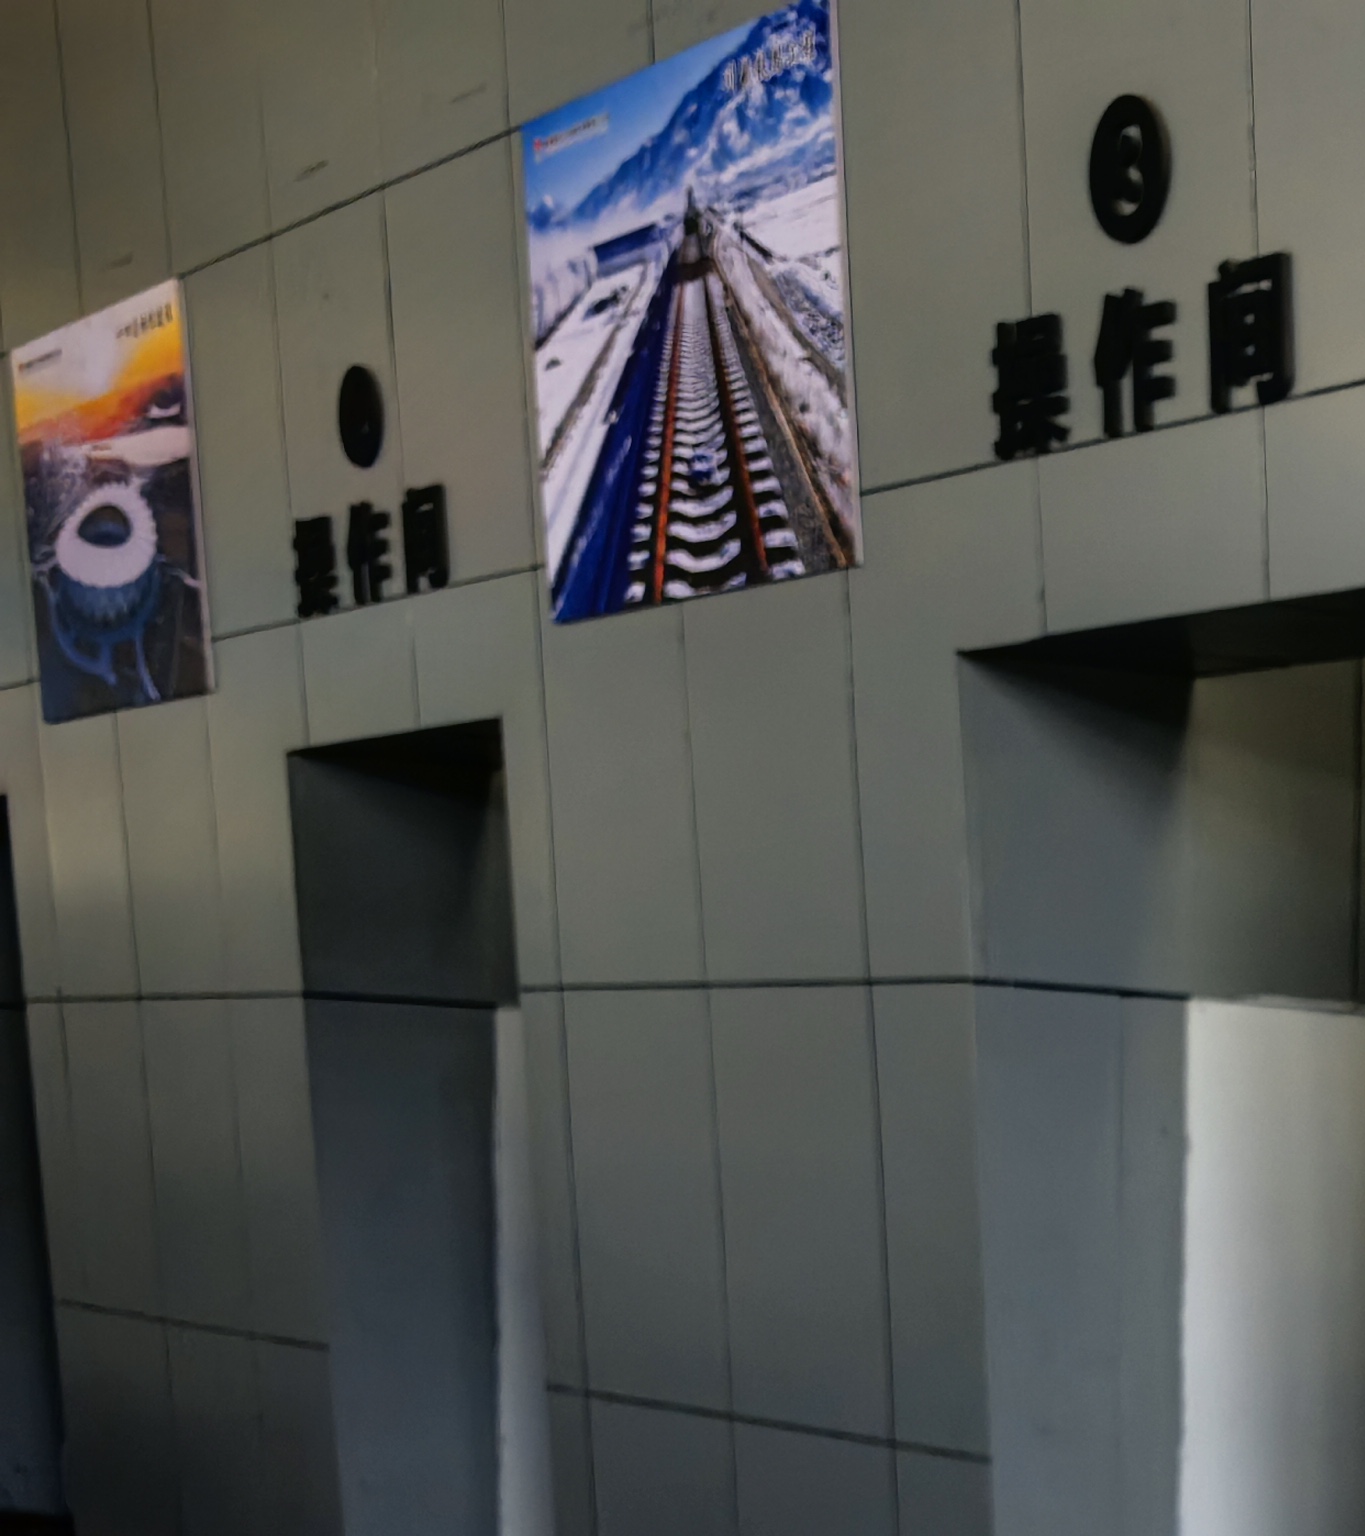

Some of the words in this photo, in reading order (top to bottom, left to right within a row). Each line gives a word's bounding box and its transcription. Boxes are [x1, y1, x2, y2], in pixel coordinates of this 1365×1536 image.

[992, 252, 1294, 461] 操作间
[294, 484, 449, 618] 操作间
